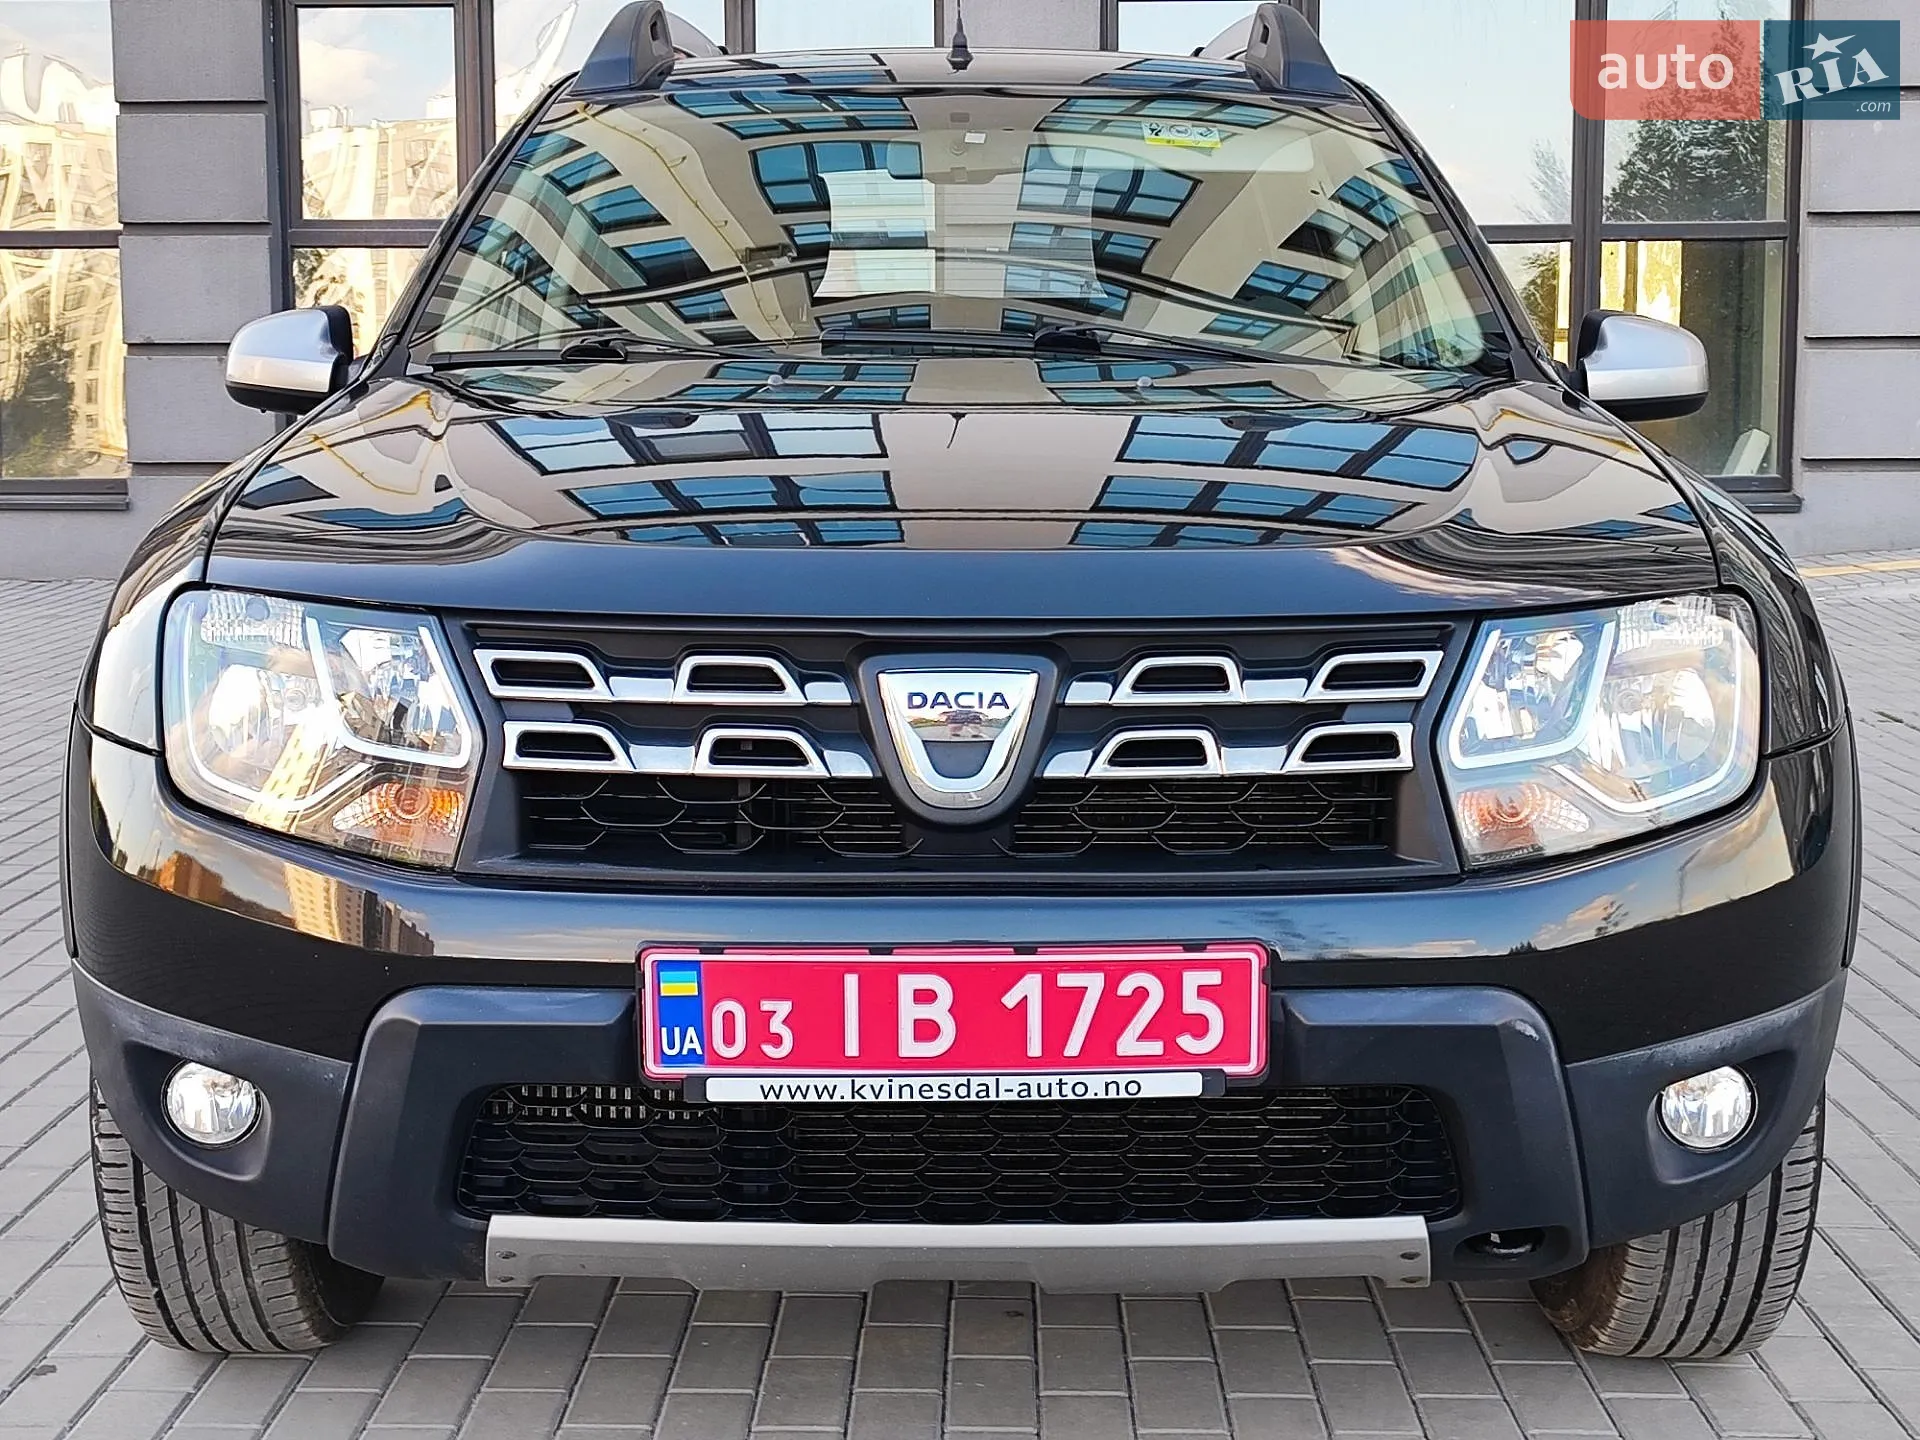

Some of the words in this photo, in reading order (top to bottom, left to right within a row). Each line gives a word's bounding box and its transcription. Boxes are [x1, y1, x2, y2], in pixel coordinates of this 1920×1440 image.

[907, 691, 1010, 710] DACIA
[711, 999, 794, 1060] 03
[1000, 969, 1226, 1058] 1725
[661, 1027, 703, 1056] UA
[760, 1077, 1142, 1101] www.kvinesdal-auto.no
